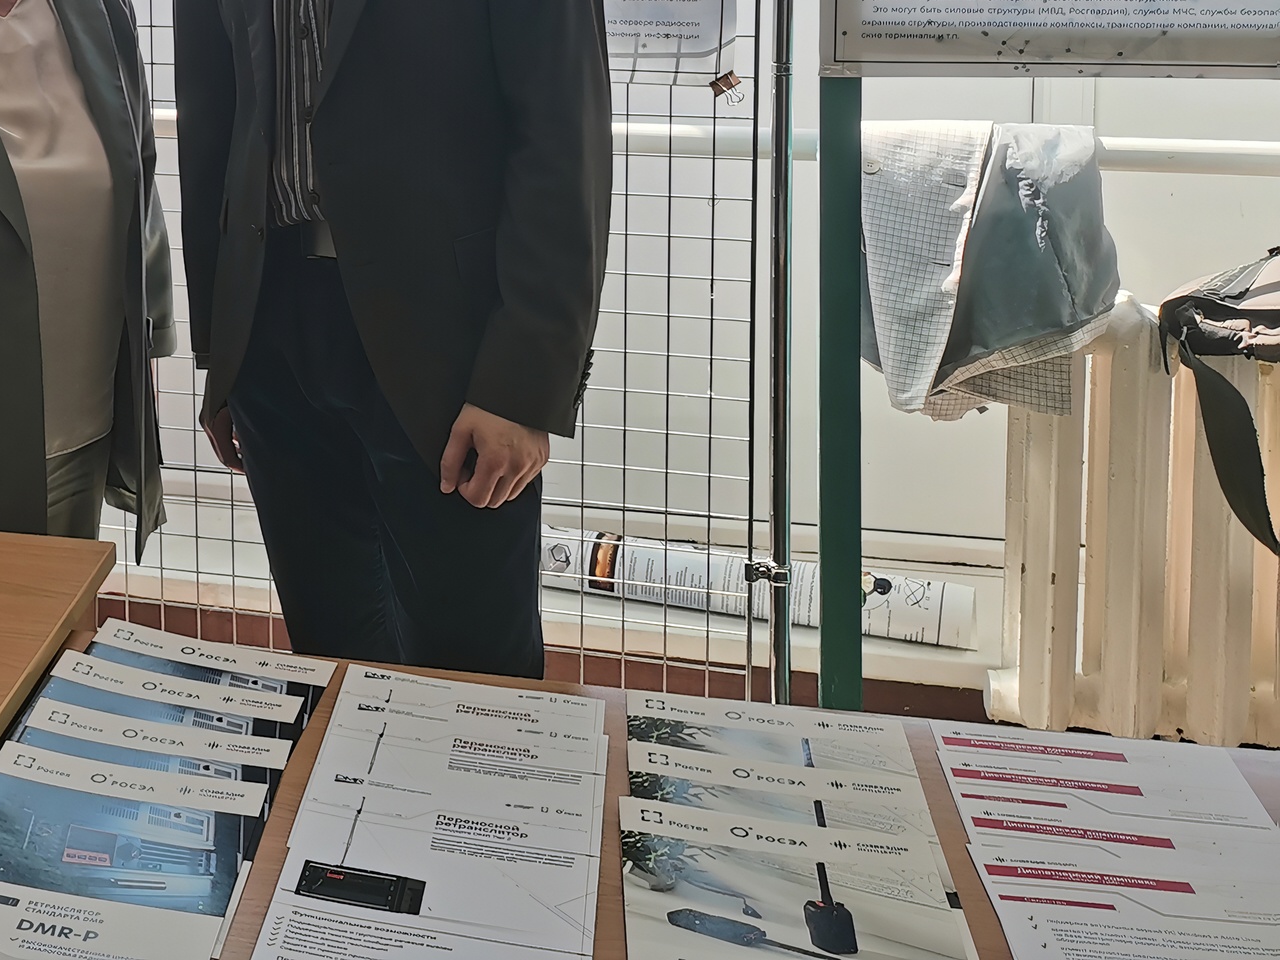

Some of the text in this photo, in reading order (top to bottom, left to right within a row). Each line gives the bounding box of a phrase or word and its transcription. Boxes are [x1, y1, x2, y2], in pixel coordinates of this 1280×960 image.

[456, 705, 531, 718] Переносной
[456, 709, 539, 724] ретранслятор
[452, 744, 539, 760] ретранслятор
[453, 739, 531, 754] Переносной
[435, 820, 528, 839] ретранслятор
[436, 814, 520, 832] Переносной
[16, 918, 99, 942] DMR-P
